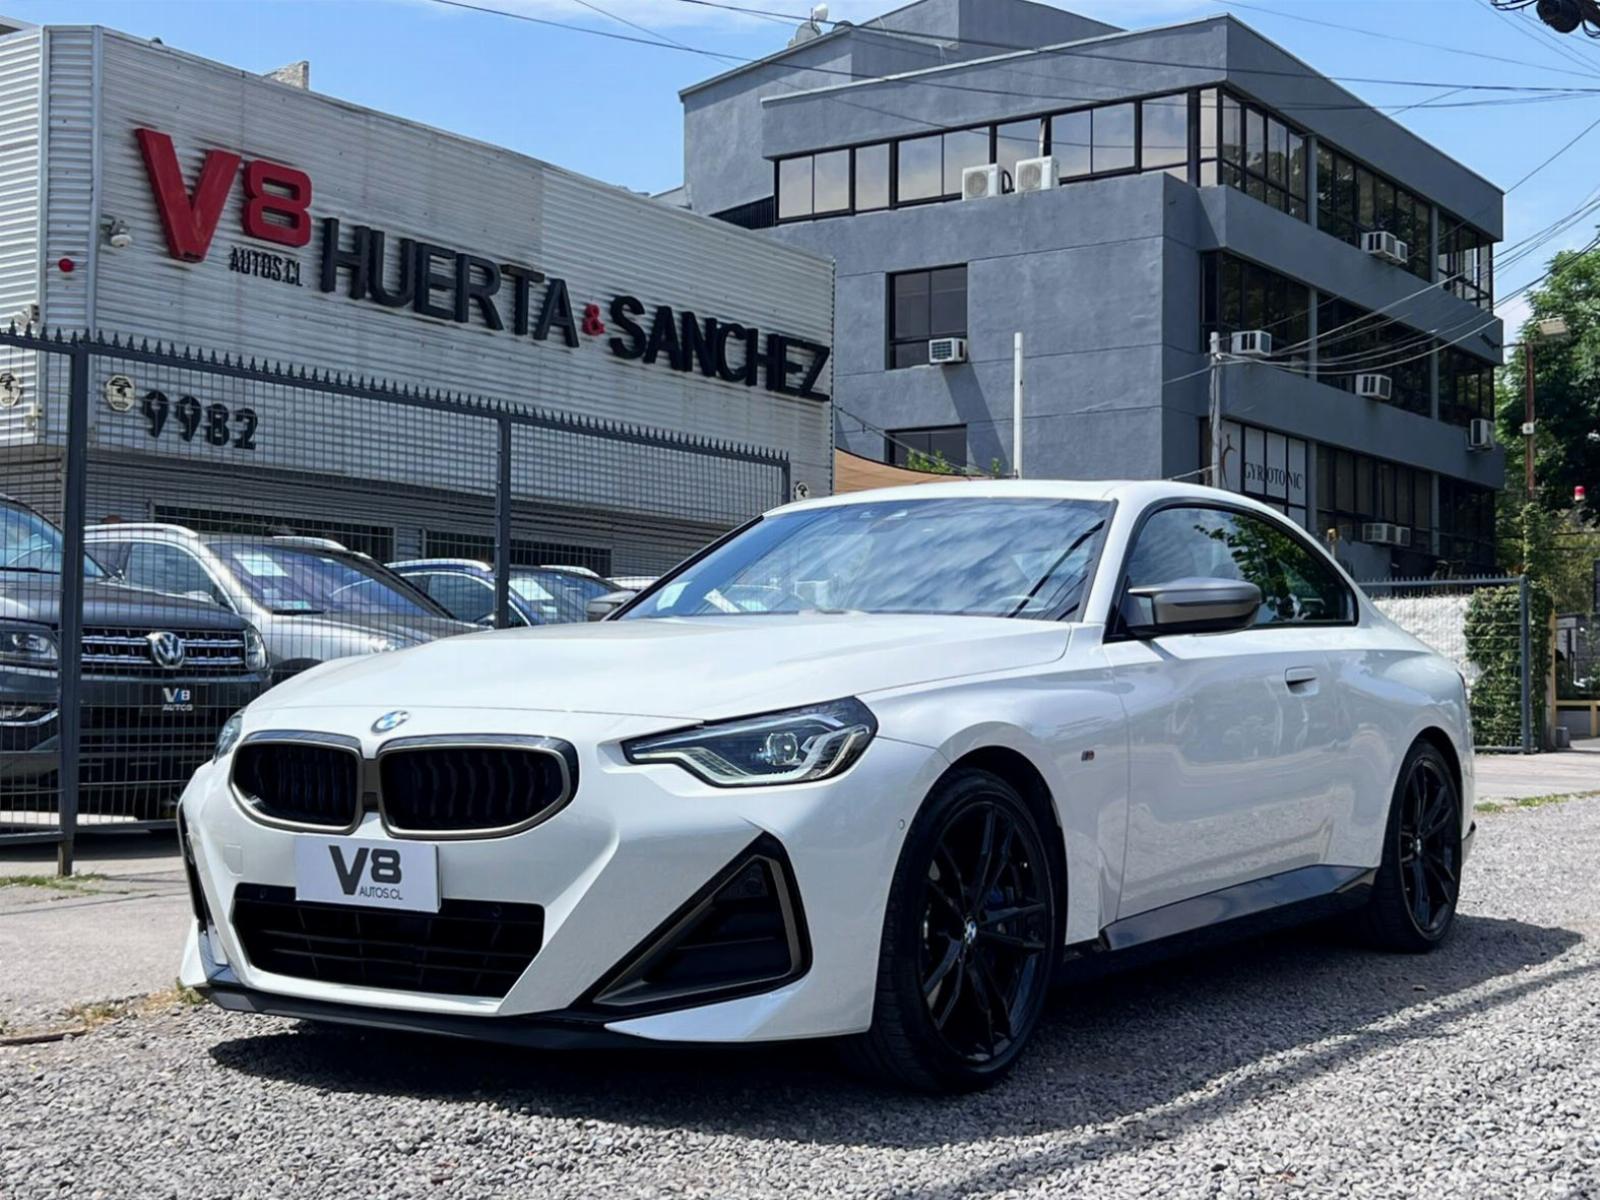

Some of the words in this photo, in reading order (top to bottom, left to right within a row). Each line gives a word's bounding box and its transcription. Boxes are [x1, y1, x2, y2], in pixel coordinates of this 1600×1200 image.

[135, 127, 312, 263] V8
[229, 246, 303, 287] AUTOS.CL
[320, 217, 579, 347] HUERTA
[582, 303, 605, 336] &
[609, 295, 830, 400] SANCHEZ
[142, 390, 258, 449] 9982
[163, 687, 191, 703] V8
[328, 845, 402, 895] V8
